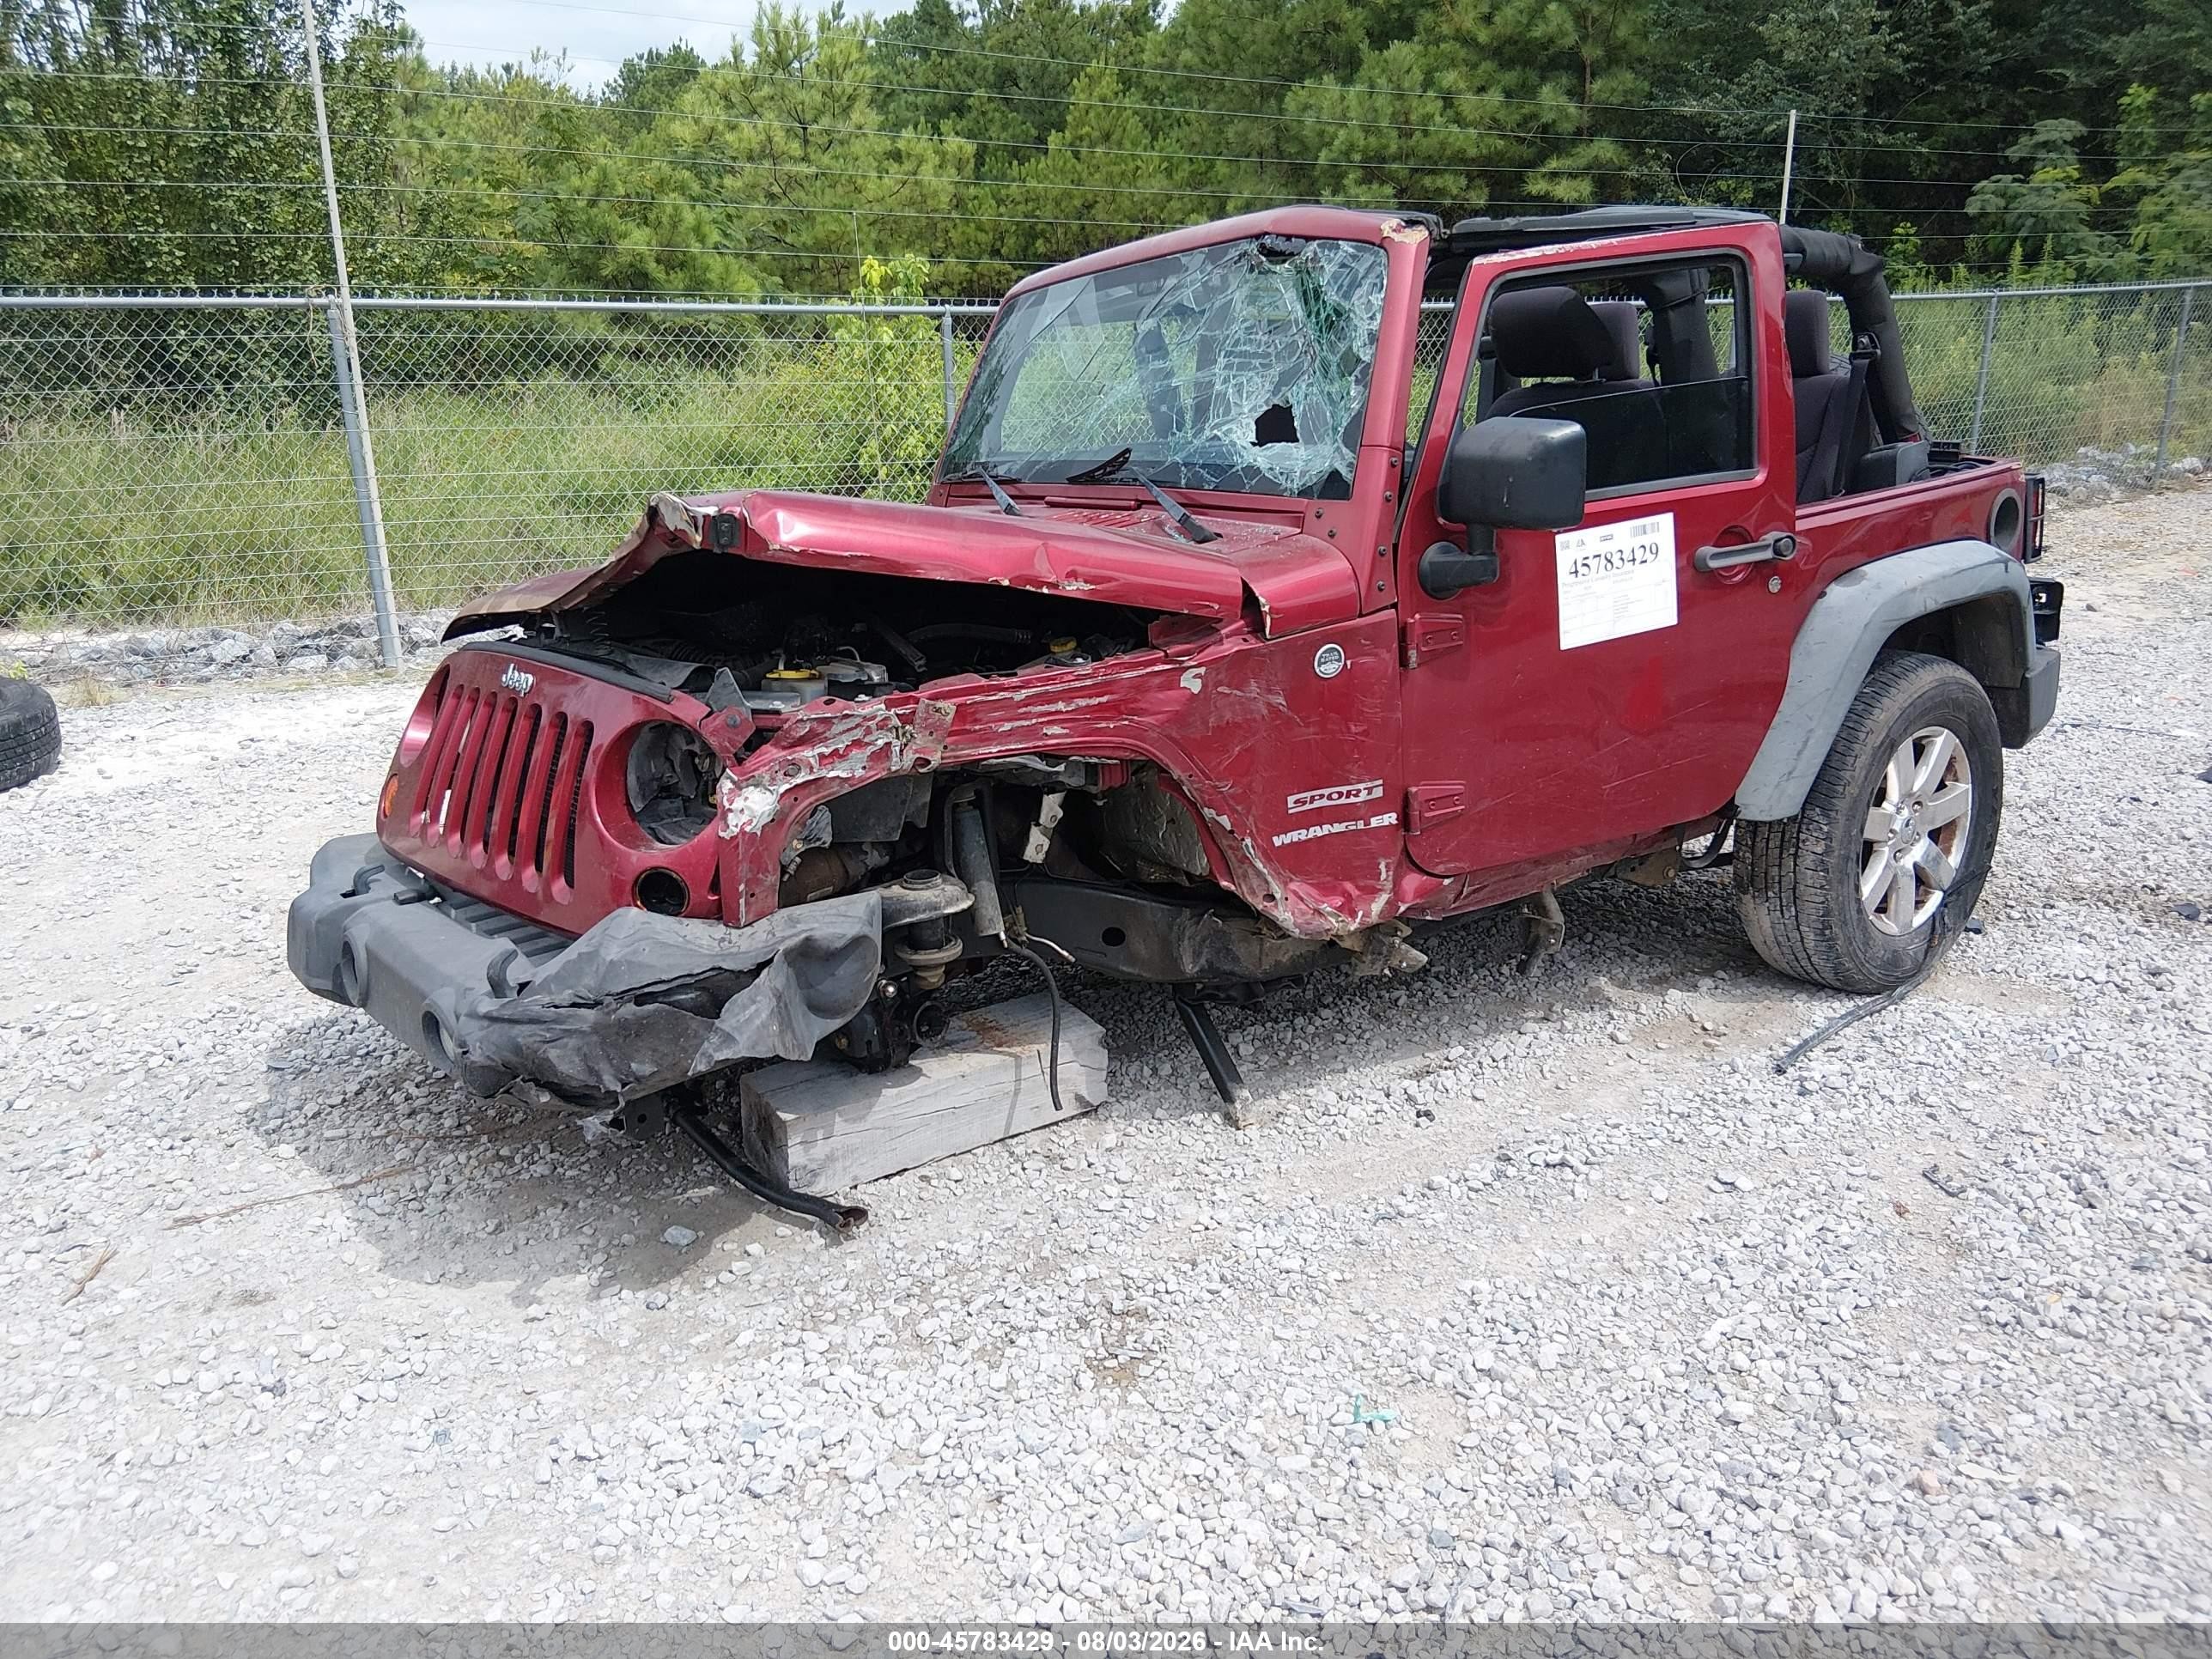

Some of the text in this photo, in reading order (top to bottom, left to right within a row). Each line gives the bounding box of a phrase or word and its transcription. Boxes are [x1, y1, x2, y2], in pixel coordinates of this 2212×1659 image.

[1568, 542, 1660, 579] 45783429
[501, 663, 534, 697] Jeep
[1292, 785, 1377, 807] SPORT
[1272, 812, 1399, 848] WRANGLER
